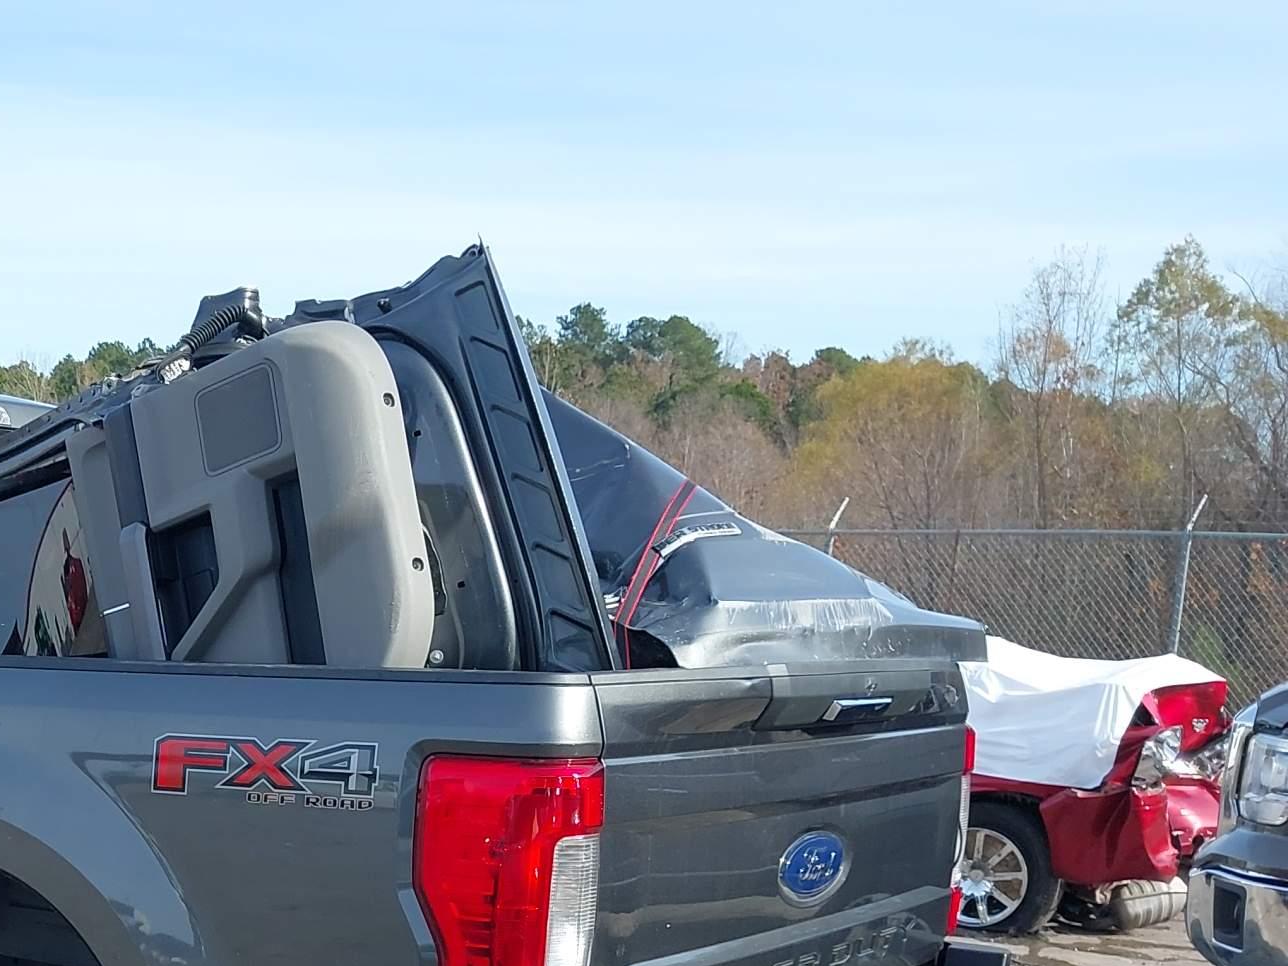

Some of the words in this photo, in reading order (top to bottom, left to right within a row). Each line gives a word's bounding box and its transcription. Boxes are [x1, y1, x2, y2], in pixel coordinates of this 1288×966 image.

[151, 732, 379, 798] FX4
[246, 791, 296, 806] OFF
[304, 796, 374, 811] ROAD
[798, 846, 837, 882] Ford
[829, 916, 917, 966] DUTY
